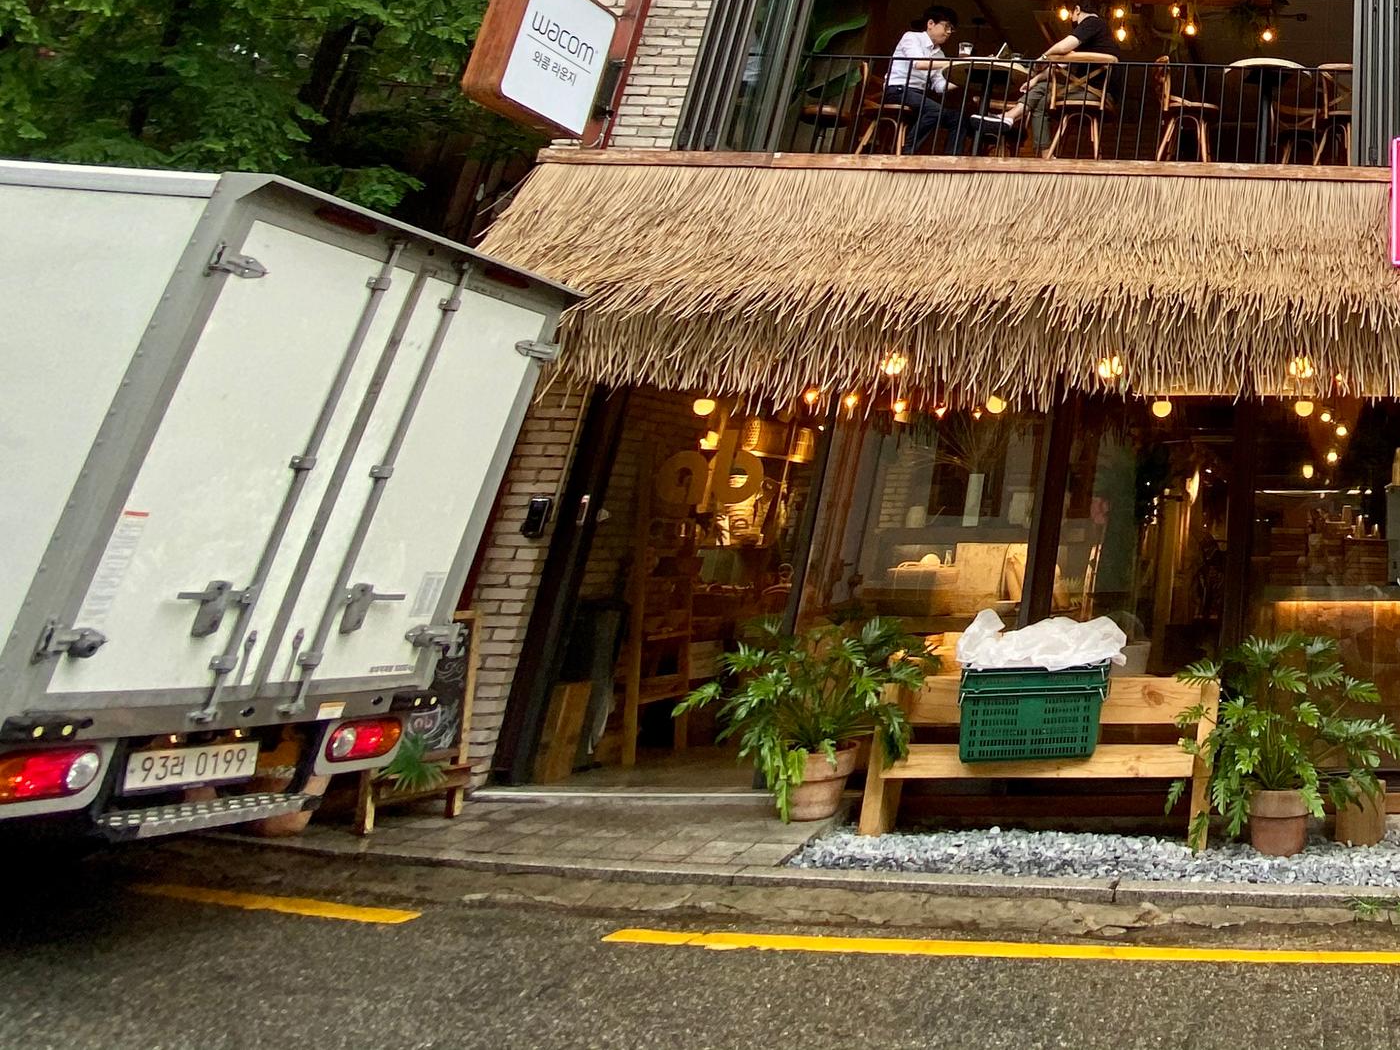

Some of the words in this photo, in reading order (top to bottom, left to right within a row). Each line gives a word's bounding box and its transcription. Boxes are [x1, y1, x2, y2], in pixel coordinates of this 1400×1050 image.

[532, 11, 595, 66] wacom
[532, 51, 551, 71] 와콤
[551, 62, 577, 87] 라운지
[195, 748, 248, 776] 0199
